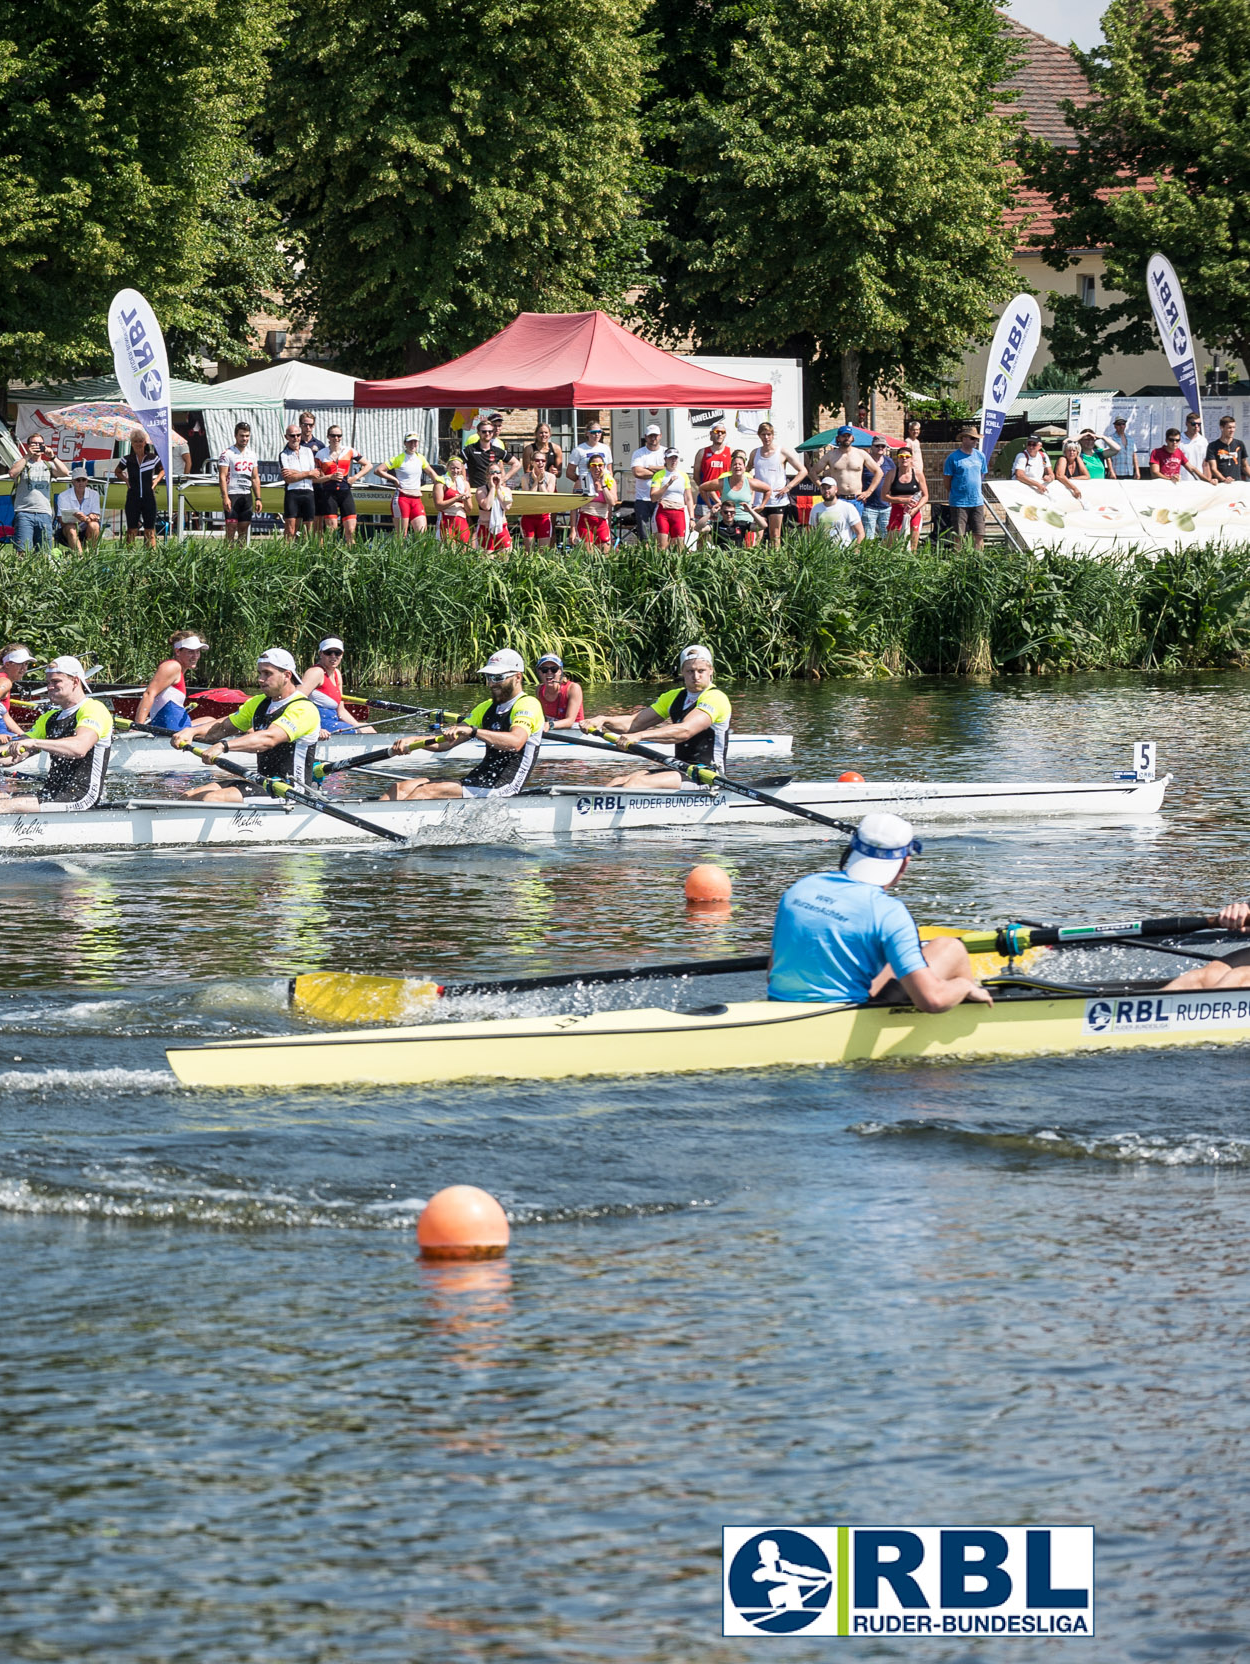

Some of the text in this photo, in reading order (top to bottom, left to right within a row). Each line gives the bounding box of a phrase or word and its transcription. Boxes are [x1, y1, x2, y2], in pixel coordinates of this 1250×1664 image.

[1000, 313, 1030, 372] RBL
[692, 410, 723, 423] HAVELLAND
[582, 477, 588, 488] 1
[1140, 744, 1150, 770] 5
[594, 796, 726, 810] RBL RUDER-BUNDESLIGA
[10, 816, 44, 835] Melitta
[1116, 1000, 1250, 1024] RBL RUDER-B
